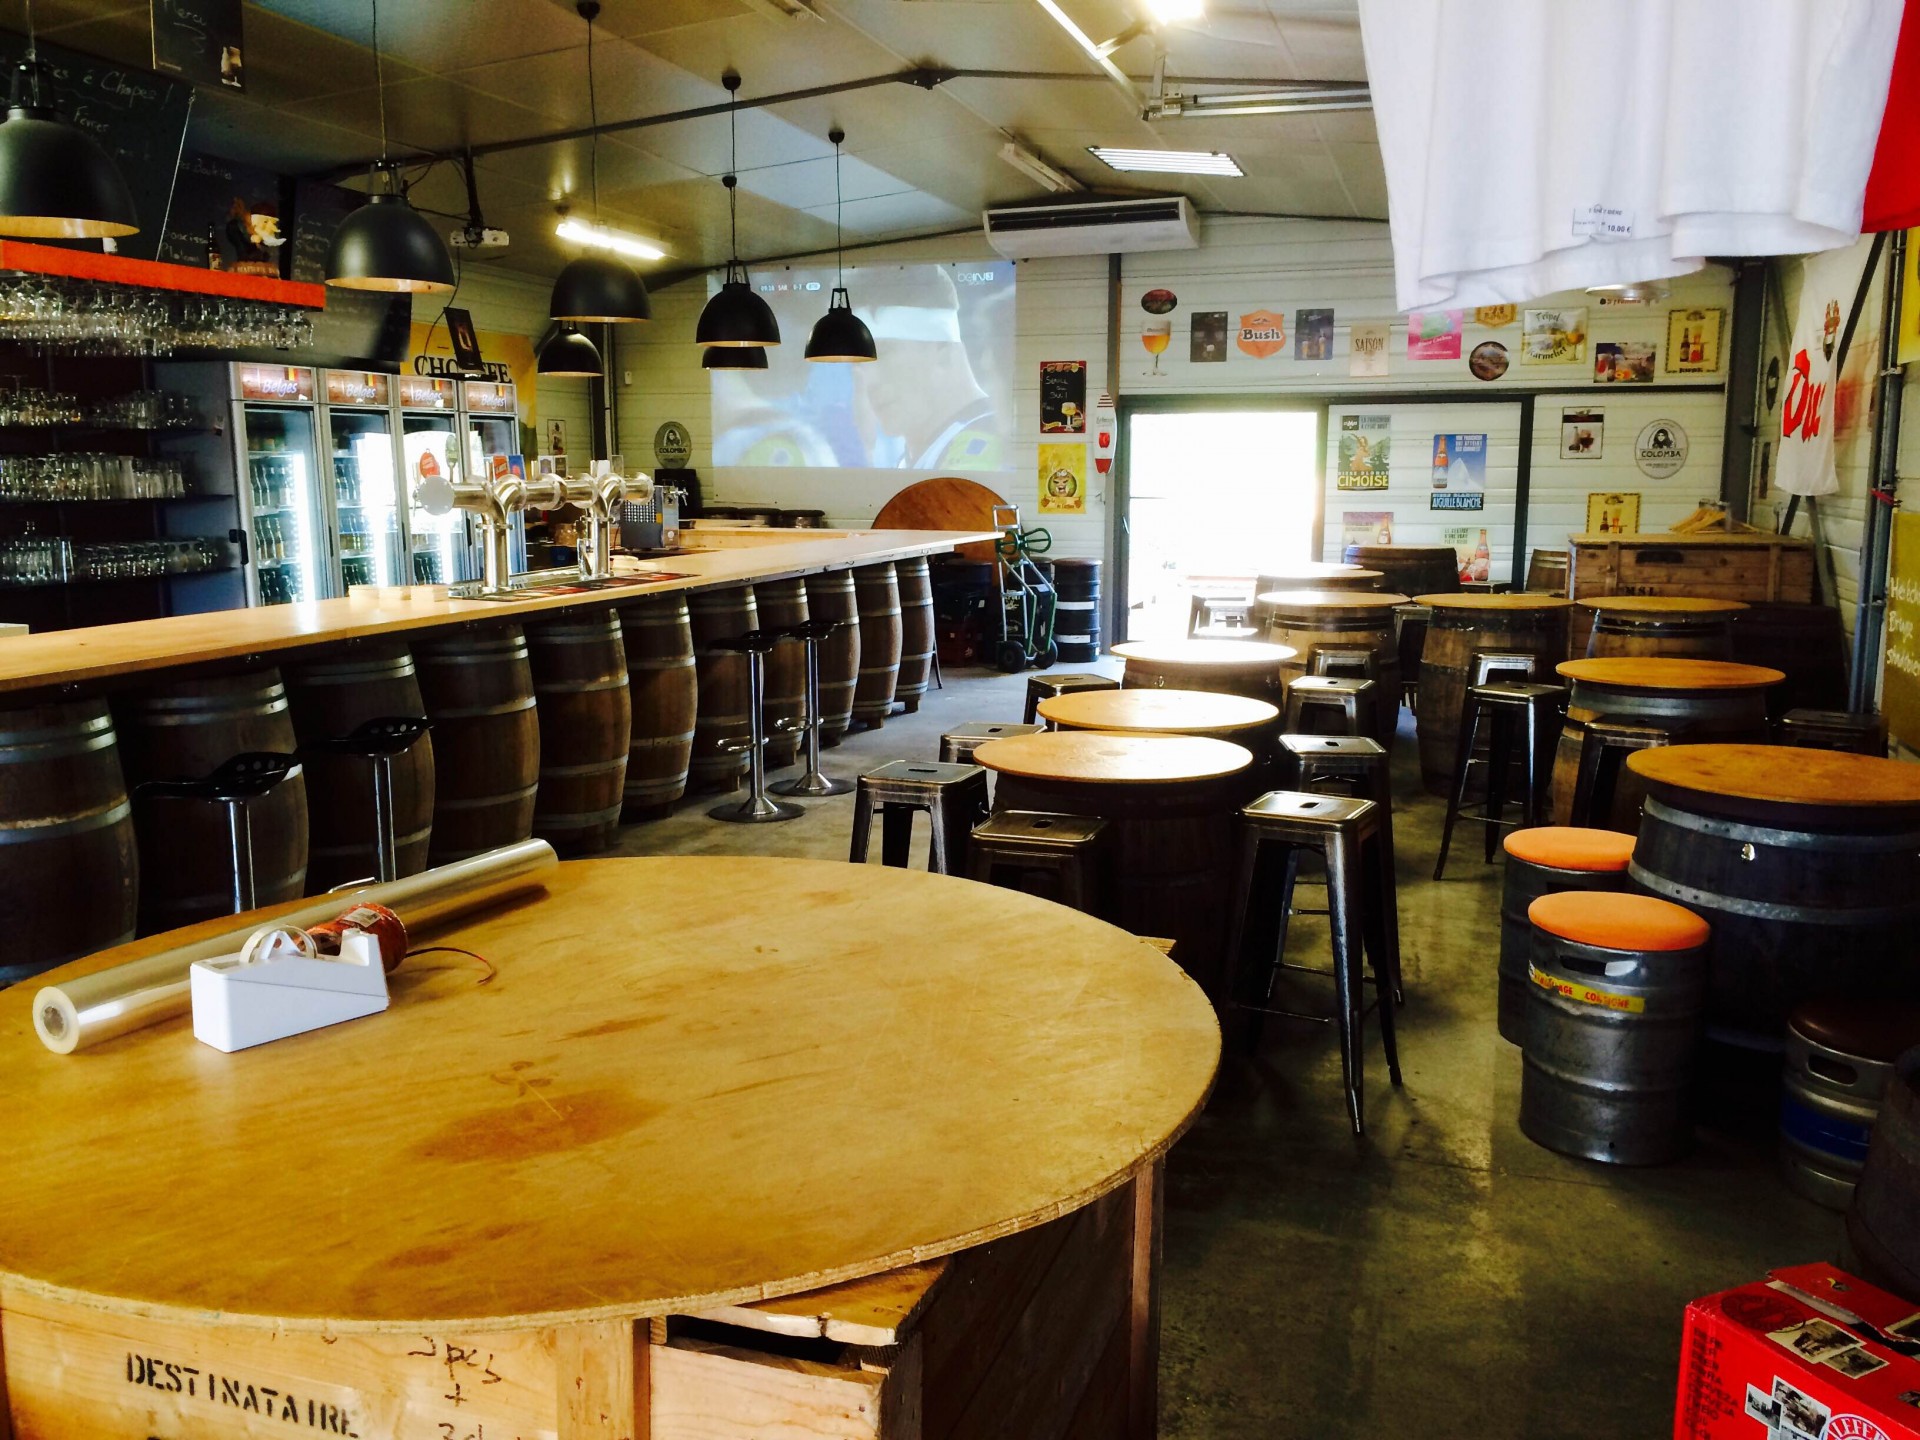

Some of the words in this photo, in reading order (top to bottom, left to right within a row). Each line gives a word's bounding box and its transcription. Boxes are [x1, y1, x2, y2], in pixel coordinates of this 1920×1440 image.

[1241, 328, 1282, 341] Bush
[1355, 337, 1384, 352] SAISON
[262, 379, 298, 398] Belges
[347, 384, 376, 399] Belges
[415, 390, 442, 403] Belges
[481, 394, 506, 407] Belges
[1641, 450, 1682, 458] COLOMBA
[1337, 476, 1389, 487] CIMOISE
[126, 1351, 359, 1439] DESTINATAIRE
